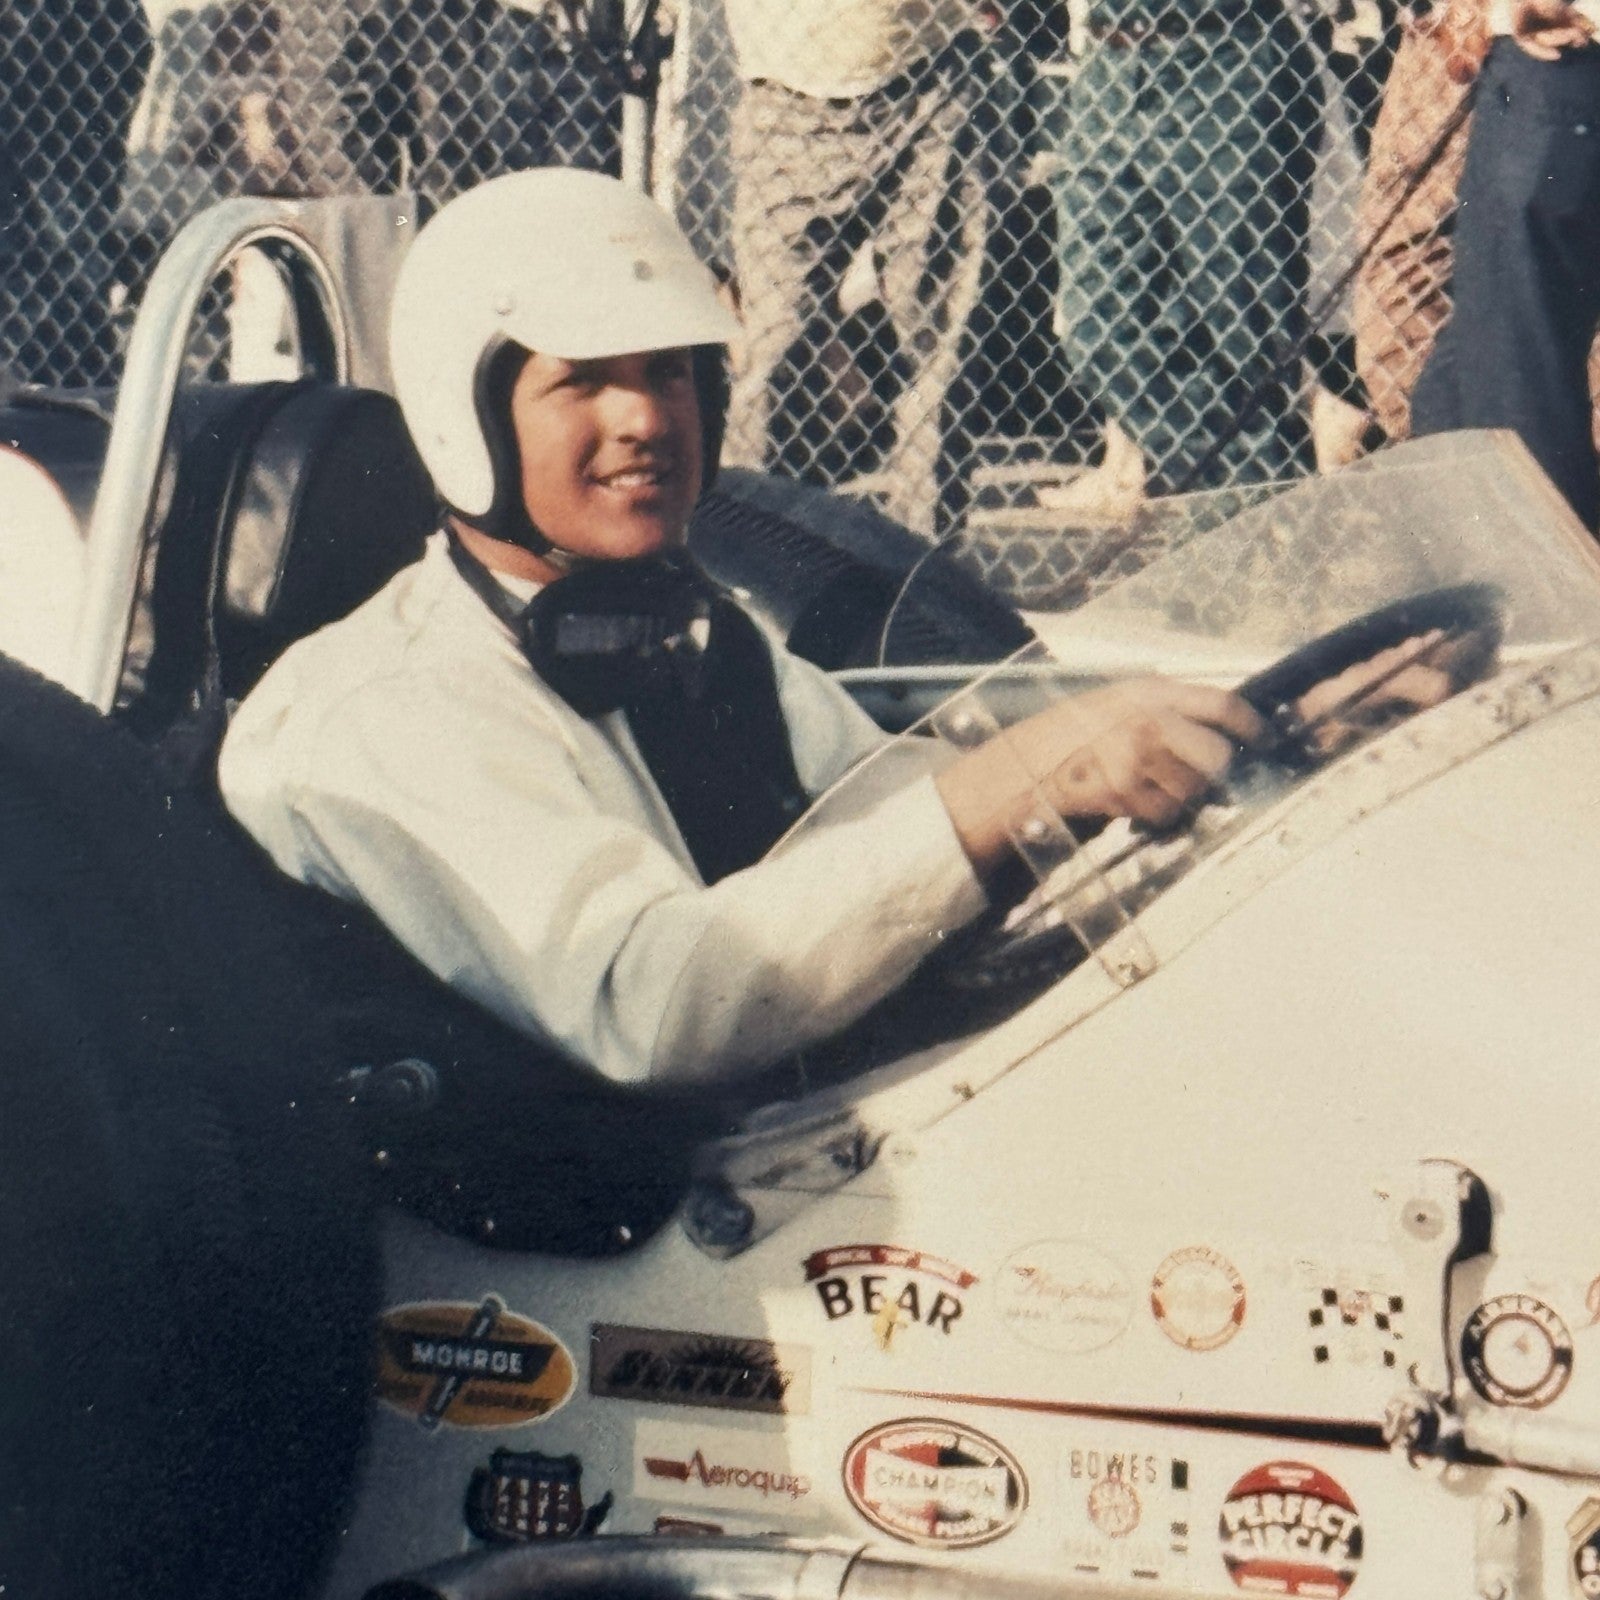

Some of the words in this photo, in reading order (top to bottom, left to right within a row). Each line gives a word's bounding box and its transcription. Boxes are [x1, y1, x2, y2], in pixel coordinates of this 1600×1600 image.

[816, 1275, 964, 1335] BEAR
[411, 1341, 523, 1374] MONROE
[874, 1466, 996, 1499] CHAMPON
[1070, 1450, 1157, 1484] BOWES
[1222, 1492, 1359, 1541] PERFECT
